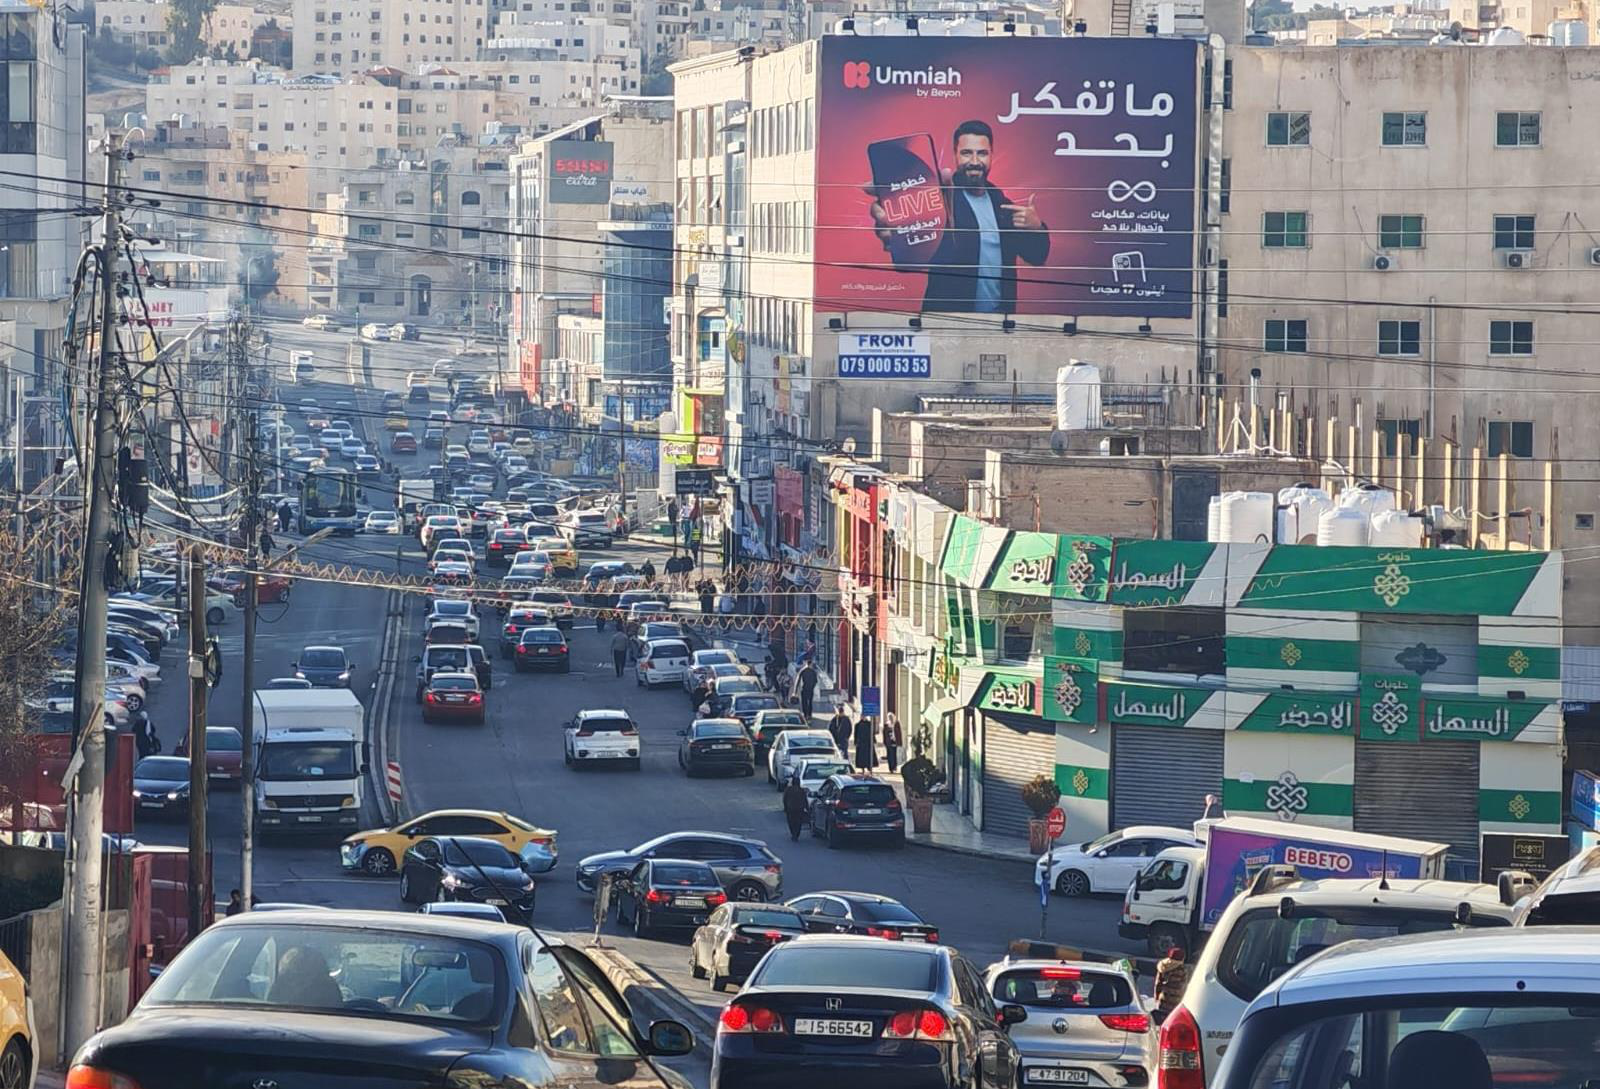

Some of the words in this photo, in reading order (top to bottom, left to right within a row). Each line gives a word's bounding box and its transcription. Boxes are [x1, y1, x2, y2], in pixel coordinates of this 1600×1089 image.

[876, 65, 961, 85] Umniah
[917, 88, 928, 98] by
[931, 88, 961, 98] Beyon
[997, 80, 1115, 124] تفكر
[1126, 83, 1174, 117] ما
[1054, 132, 1174, 168] بحد
[884, 187, 944, 222] LIVE
[1091, 209, 1135, 219] مكالمات
[1102, 223, 1117, 231] حد
[858, 335, 915, 347] FRONT
[841, 357, 865, 373] 079
[868, 357, 891, 373] 000
[894, 357, 909, 373] 53
[912, 357, 928, 373] 53
[1113, 561, 1186, 590] السهل
[1113, 690, 1186, 720] السهل
[1429, 705, 1510, 736] السهل
[1287, 849, 1351, 870] BEBETO
